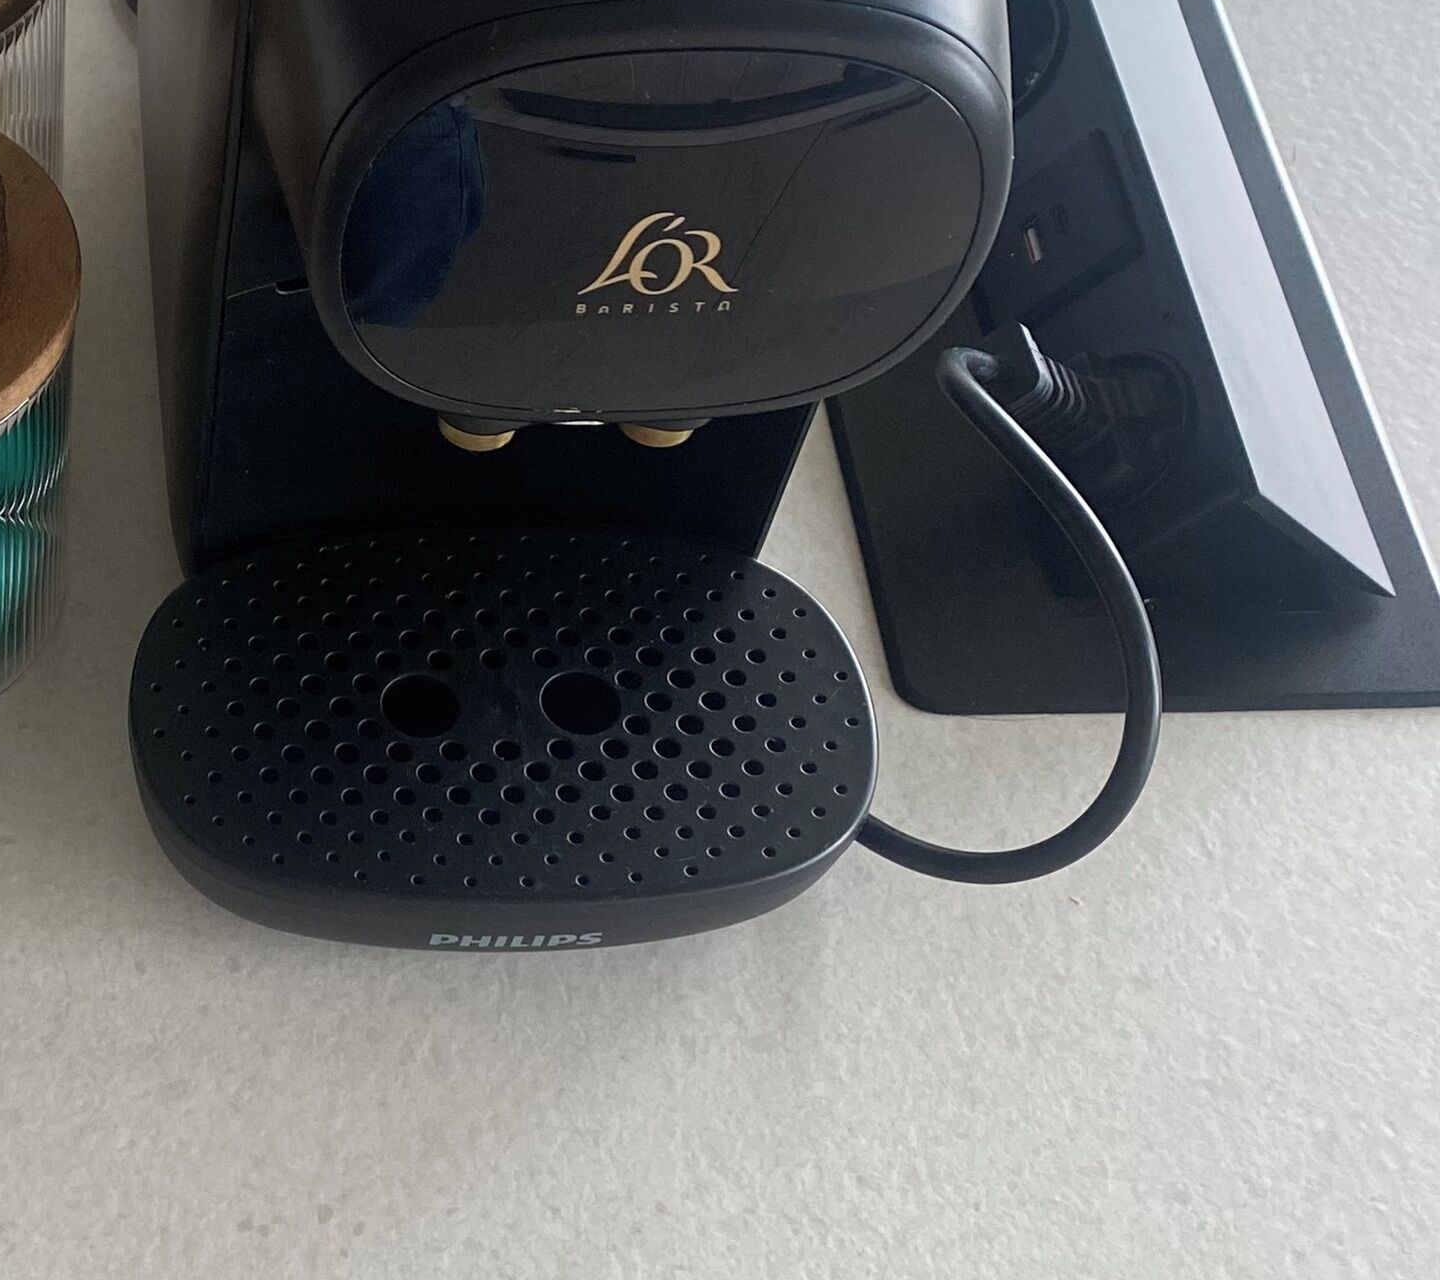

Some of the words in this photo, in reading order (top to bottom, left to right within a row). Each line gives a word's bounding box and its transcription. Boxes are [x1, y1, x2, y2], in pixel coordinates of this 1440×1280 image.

[576, 211, 739, 295] L'OR
[575, 300, 731, 315] BARISTA
[428, 932, 604, 948] PHILIPS
